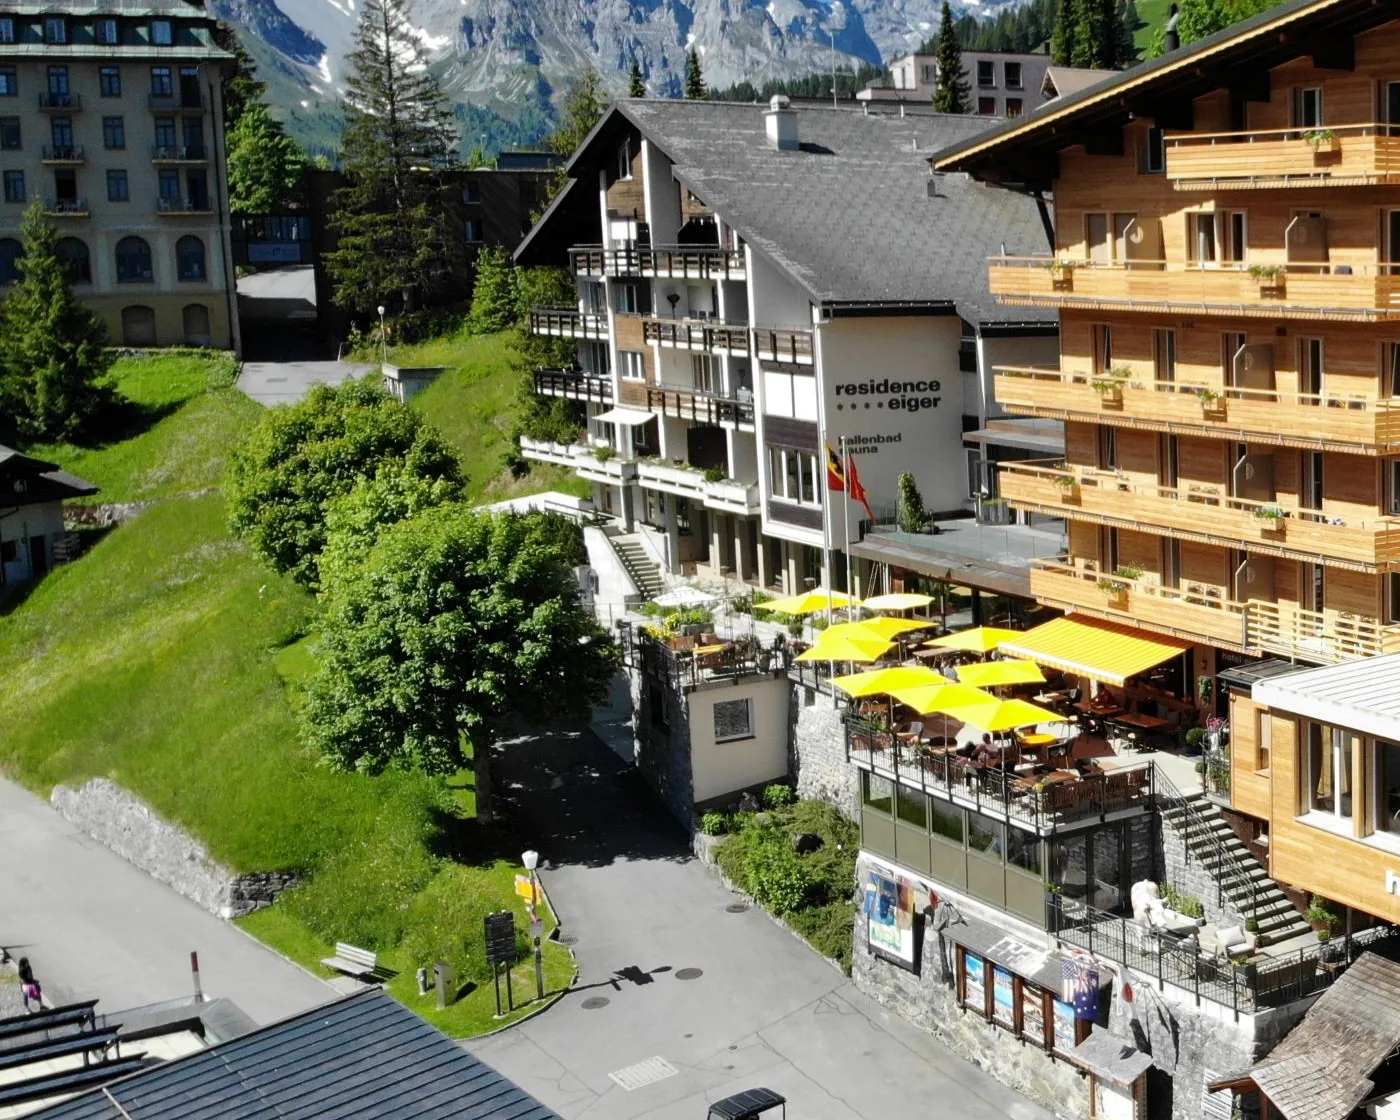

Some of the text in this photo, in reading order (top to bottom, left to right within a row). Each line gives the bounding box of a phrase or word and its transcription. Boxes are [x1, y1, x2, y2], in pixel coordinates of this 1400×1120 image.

[836, 379, 941, 396] residence
[888, 394, 942, 412] eiger
[838, 433, 902, 445] hallenbad
